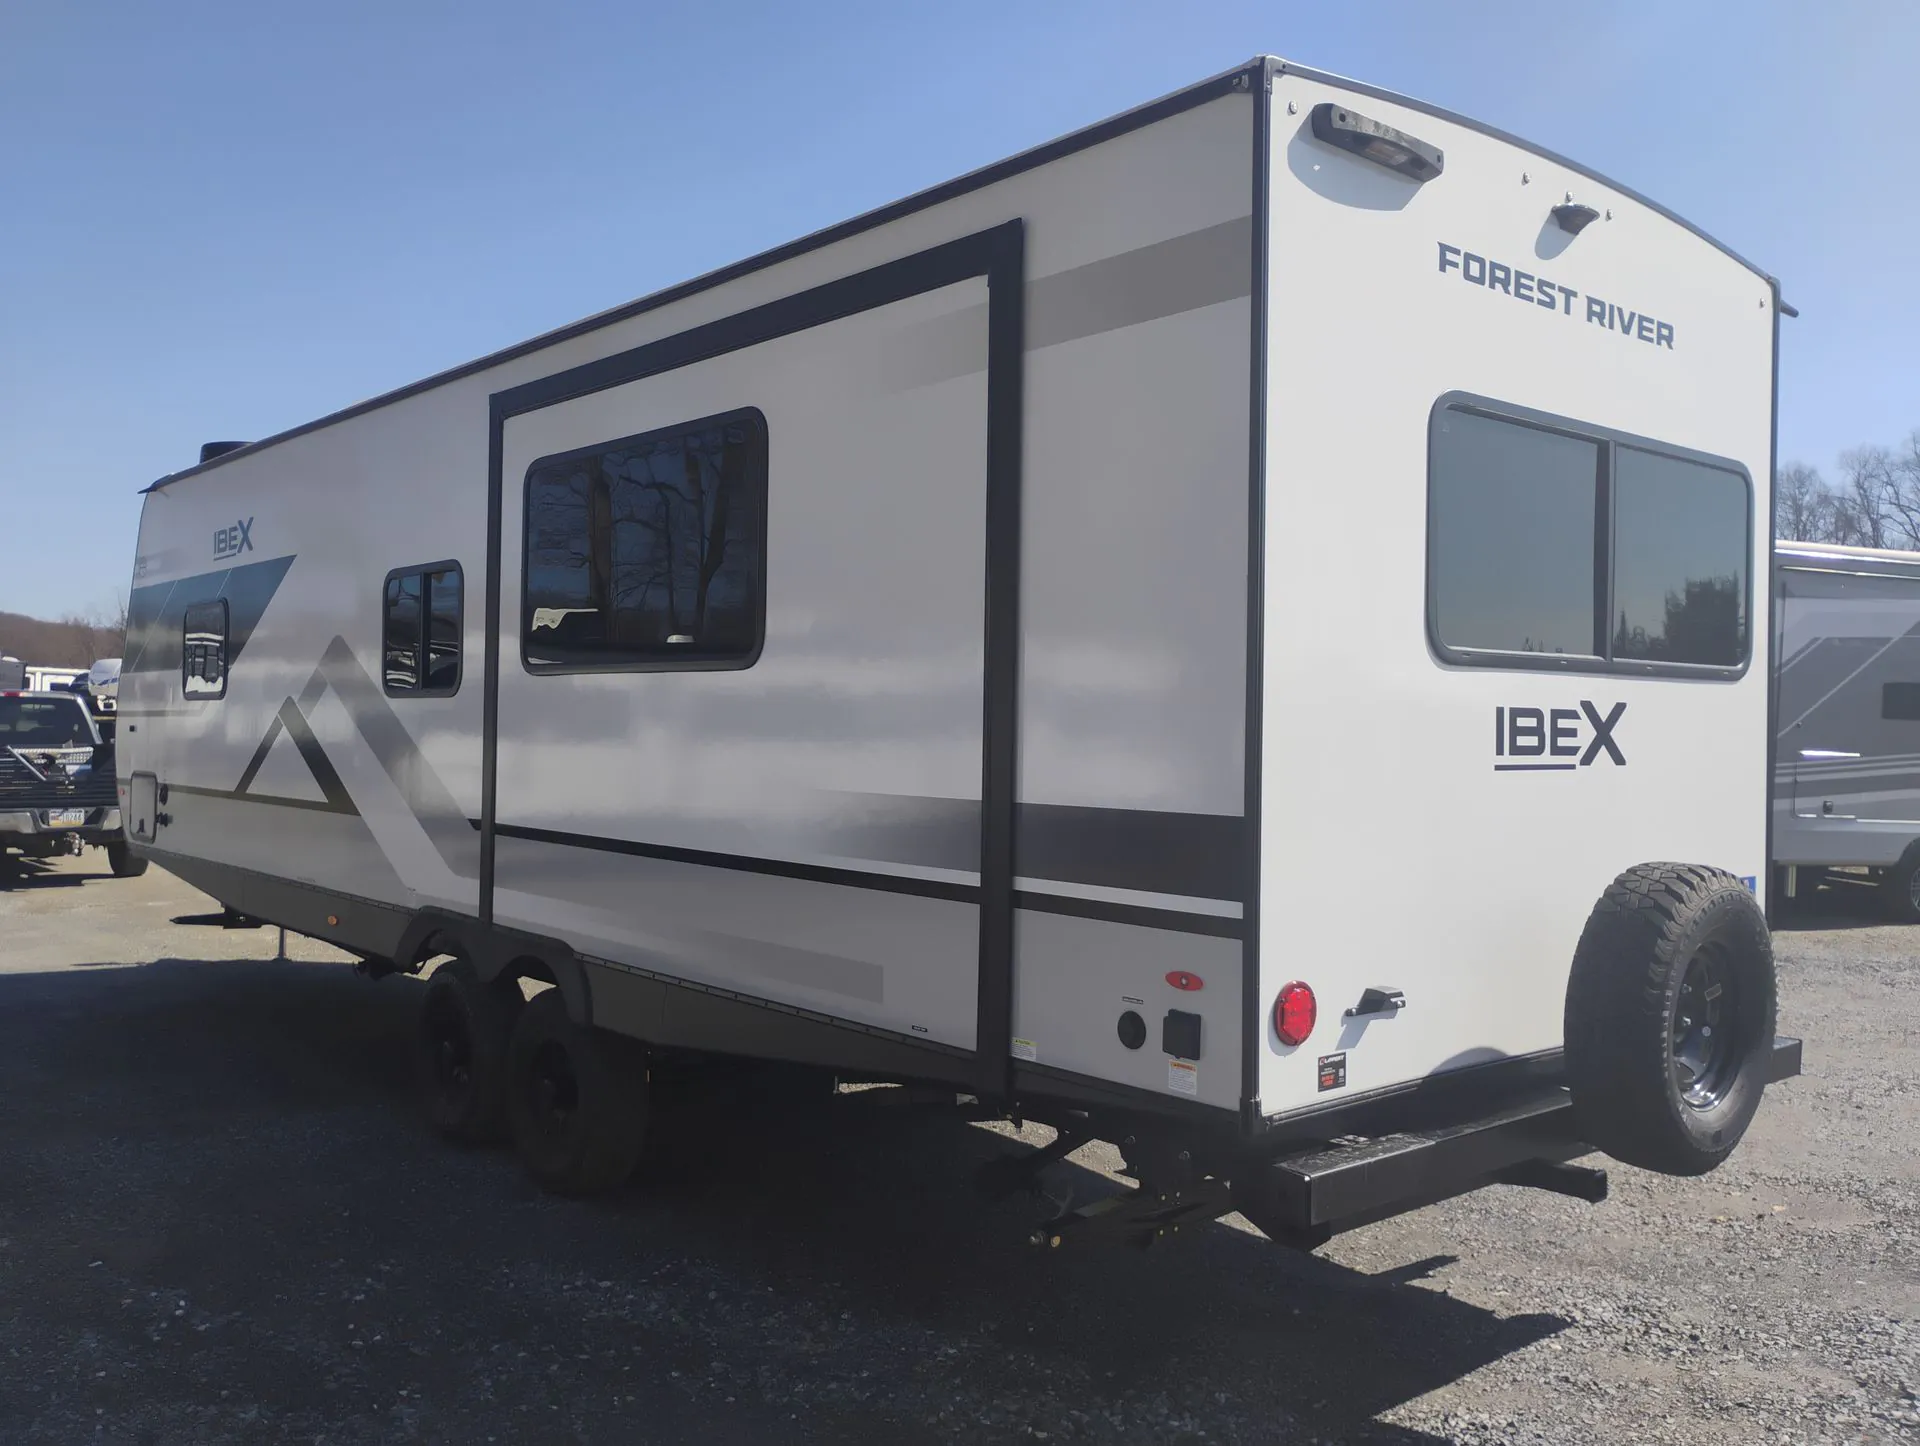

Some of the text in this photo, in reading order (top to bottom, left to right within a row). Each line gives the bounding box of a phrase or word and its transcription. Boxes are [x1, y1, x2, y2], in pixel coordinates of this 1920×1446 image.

[1437, 241, 1675, 350] FOREST RIVER
[213, 516, 254, 554] IBEX
[1495, 700, 1628, 766] IBEX
